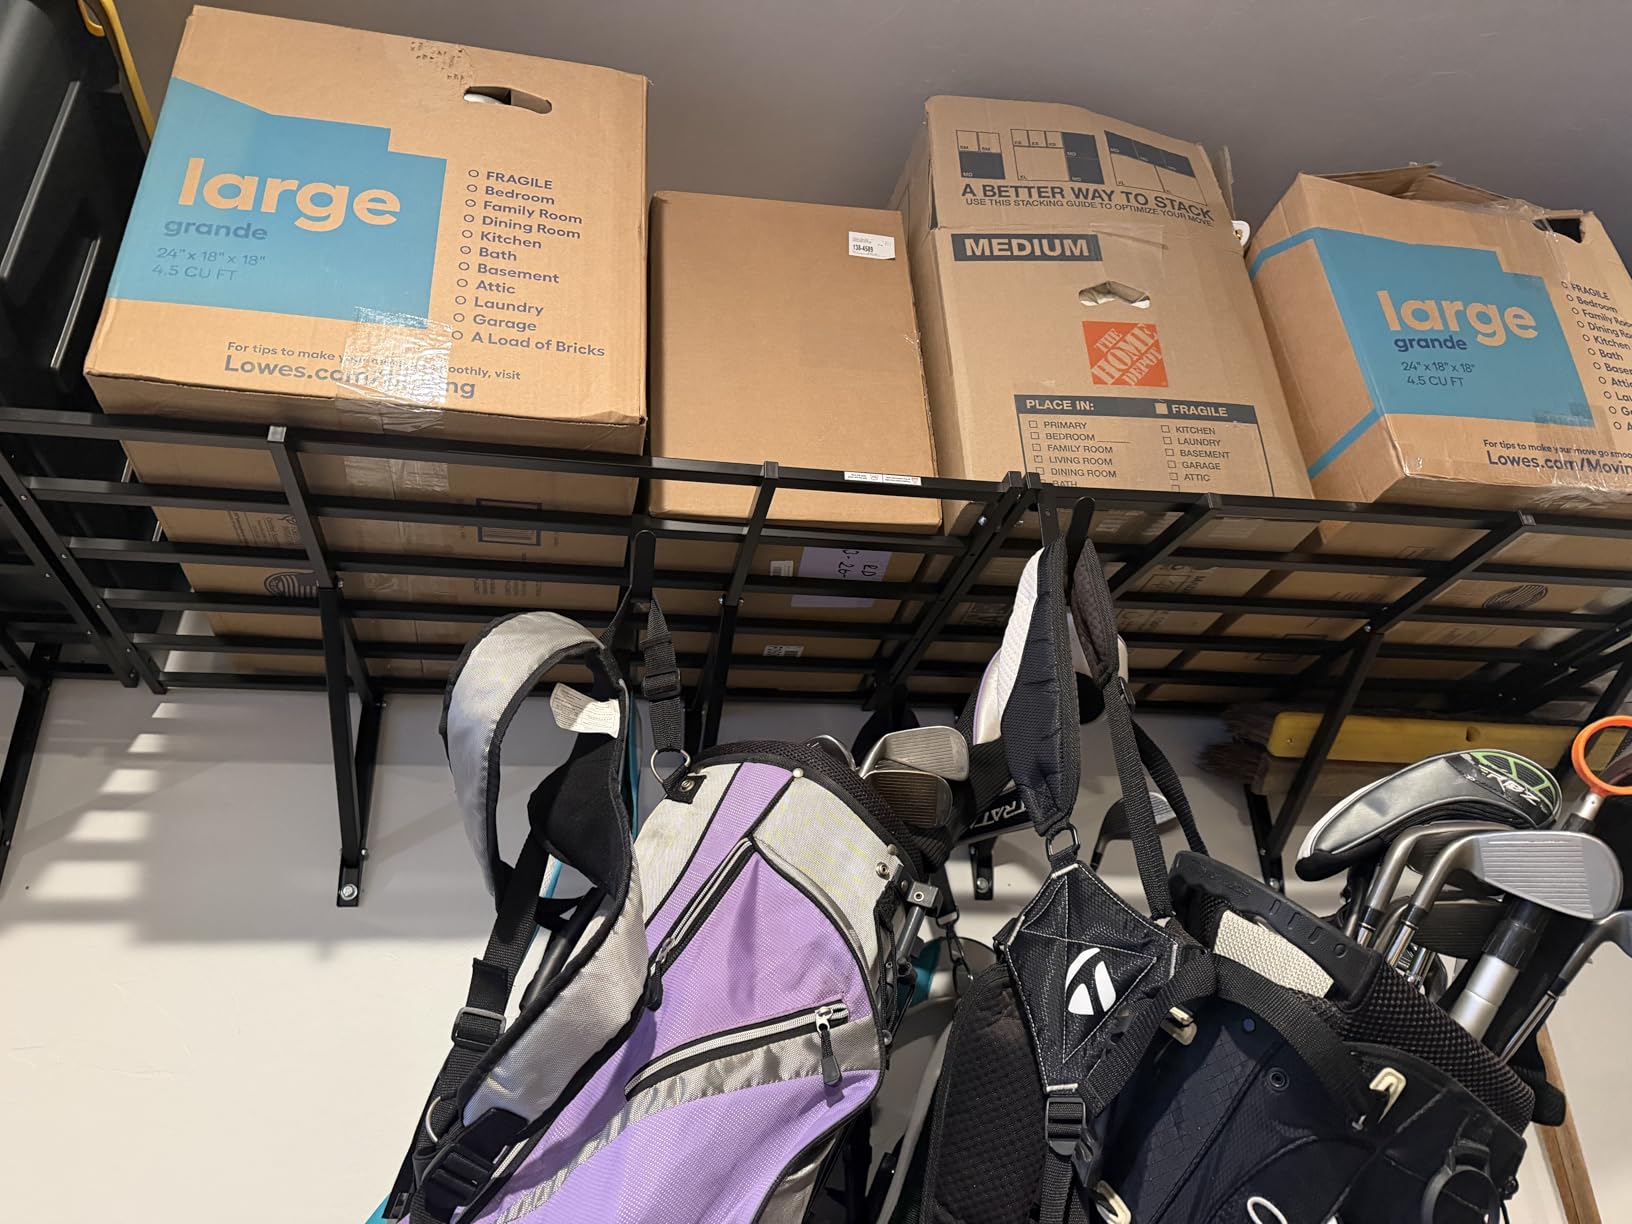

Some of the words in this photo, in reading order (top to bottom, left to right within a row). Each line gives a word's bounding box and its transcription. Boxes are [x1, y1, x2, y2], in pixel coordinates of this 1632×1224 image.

[486, 171, 553, 190] FRAGILE
[178, 157, 401, 232] large
[485, 186, 555, 205] Bedroom
[961, 184, 977, 197] A
[982, 184, 1065, 199] BETTER
[1070, 186, 1115, 202] WAY
[1120, 191, 1149, 206] TO
[1154, 196, 1215, 221] STACK
[483, 200, 535, 218] Family
[539, 208, 583, 224] Room
[966, 198, 987, 206] USE
[989, 199, 1011, 207] THIS
[1013, 199, 1064, 207] STACKING
[1065, 200, 1098, 209] GUIDE
[1099, 202, 1113, 210] TO
[1114, 203, 1160, 215] OPTIMIZE
[1160, 210, 1187, 219] YOUR
[163, 220, 268, 240] grande
[482, 215, 533, 233] Dining
[537, 224, 581, 239] Room
[480, 231, 542, 249] Kitchen
[963, 238, 1090, 257] MEDIUM
[156, 247, 186, 258] 24"
[187, 252, 197, 260] x
[202, 251, 225, 262] 18"
[242, 255, 266, 266] 18"
[479, 247, 517, 261] Bath
[152, 264, 179, 276] 4.5
[184, 266, 211, 279] CU
[216, 268, 240, 280] FT
[477, 263, 560, 284] Basement
[475, 280, 516, 294] Attic
[1571, 283, 1610, 300] FRAGILE
[474, 296, 544, 316] Laundry
[1576, 296, 1618, 313] Bedroom
[473, 314, 537, 332] Garage
[1376, 290, 1538, 346] large
[1582, 309, 1613, 324] Family
[1613, 316, 1632, 328] Roo
[1588, 322, 1619, 338] Dining
[471, 331, 483, 343] A
[488, 333, 531, 348] Load
[535, 339, 552, 350] of
[556, 341, 605, 357] Bricks
[1094, 328, 1123, 353] THE
[1394, 334, 1468, 352] grande
[1593, 335, 1631, 350] Kitchen
[227, 342, 249, 352] For
[252, 344, 277, 356] tips
[281, 347, 294, 356] to
[298, 350, 335, 360] make
[1091, 324, 1158, 385] HOME
[1599, 348, 1624, 361] Bath
[495, 369, 521, 380] visit
[1121, 347, 1162, 385] DEPOT
[1401, 361, 1421, 371] 24"
[1423, 363, 1431, 371] x
[1432, 361, 1448, 372] 18"
[1460, 363, 1475, 373] 18"
[1407, 376, 1426, 386] 4.5
[1428, 376, 1448, 386] CU
[1450, 376, 1464, 387] FT
[1026, 399, 1072, 411] PLACE
[1076, 400, 1095, 411] IN:
[1172, 405, 1228, 417] FRAGILE
[1043, 420, 1087, 429] PRIMARY
[1175, 426, 1216, 435] KITCHEN
[1045, 432, 1096, 441] BEDROOM
[1177, 437, 1221, 447] LAUNDRY
[1047, 444, 1081, 453] FAMILY
[1083, 445, 1113, 454] ROOM
[1180, 449, 1231, 459] BASEMENT
[1483, 439, 1497, 448] For
[1499, 441, 1516, 450] tips
[1528, 444, 1551, 453] make
[1553, 446, 1572, 455] your
[1573, 447, 1597, 456] move
[1598, 450, 1609, 458] go
[1049, 456, 1081, 465] LIVING
[1082, 457, 1113, 466] ROOM
[1182, 461, 1221, 470] GARAGE
[1051, 468, 1085, 477] DINING
[1087, 469, 1117, 478] ROOM
[1184, 473, 1211, 482] ATTIC
